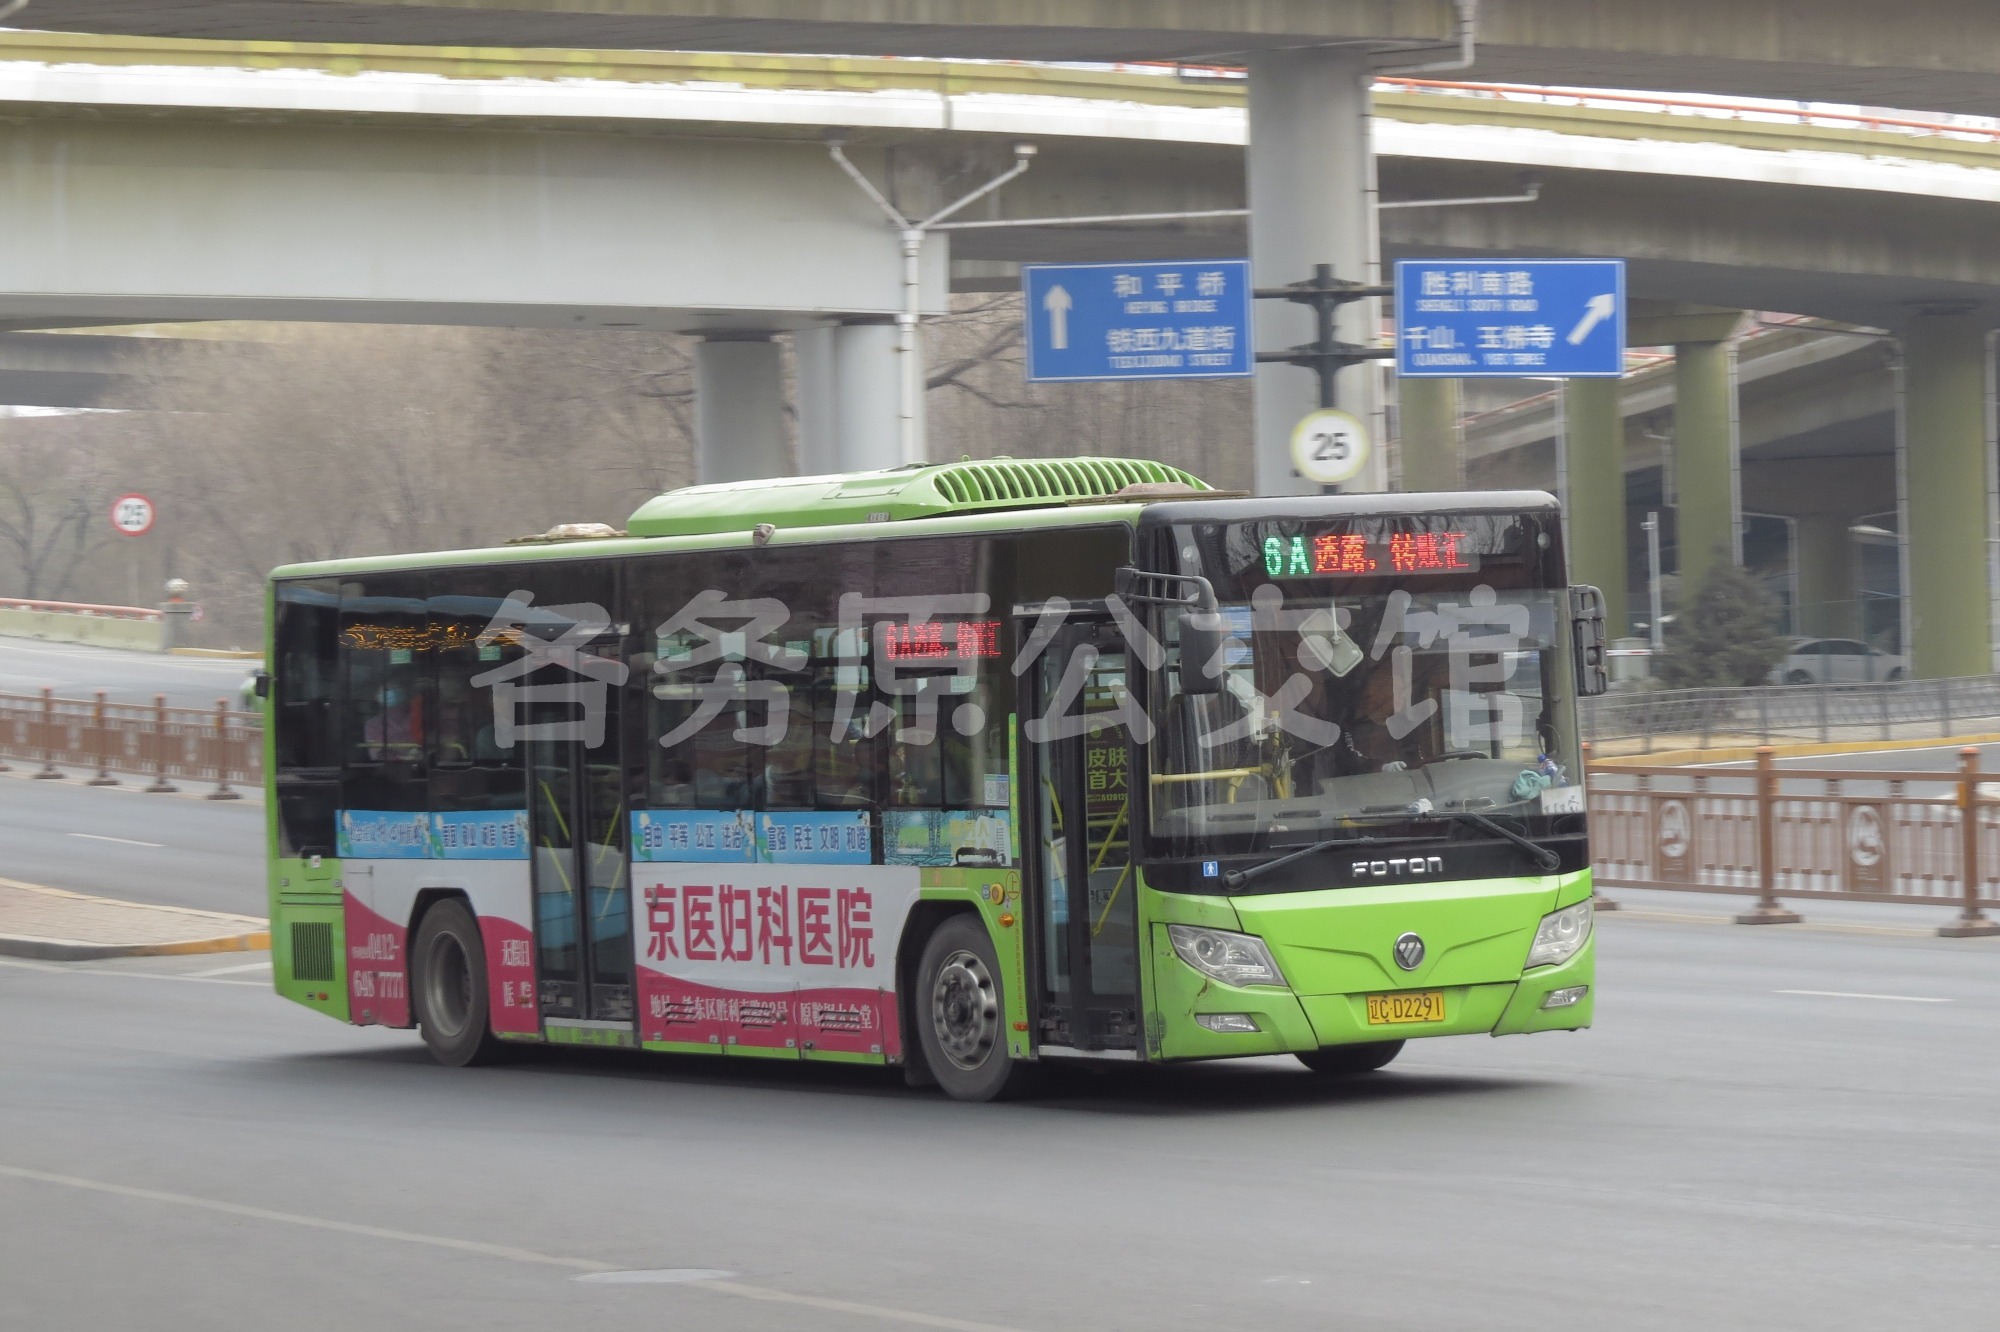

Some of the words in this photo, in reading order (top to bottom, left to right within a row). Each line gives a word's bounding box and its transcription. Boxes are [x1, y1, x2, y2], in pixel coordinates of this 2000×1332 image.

[1112, 271, 1227, 298] 和平桥
[1421, 271, 1535, 296] 胜利南路
[1105, 325, 1236, 353] 铁西九道街
[1311, 432, 1350, 461] 25
[1264, 536, 1310, 575] 6A
[1088, 747, 1128, 768] 皮肤
[1088, 769, 1128, 790] 首大
[1352, 856, 1443, 878] FOTON
[644, 883, 876, 969] 京医妇科医院
